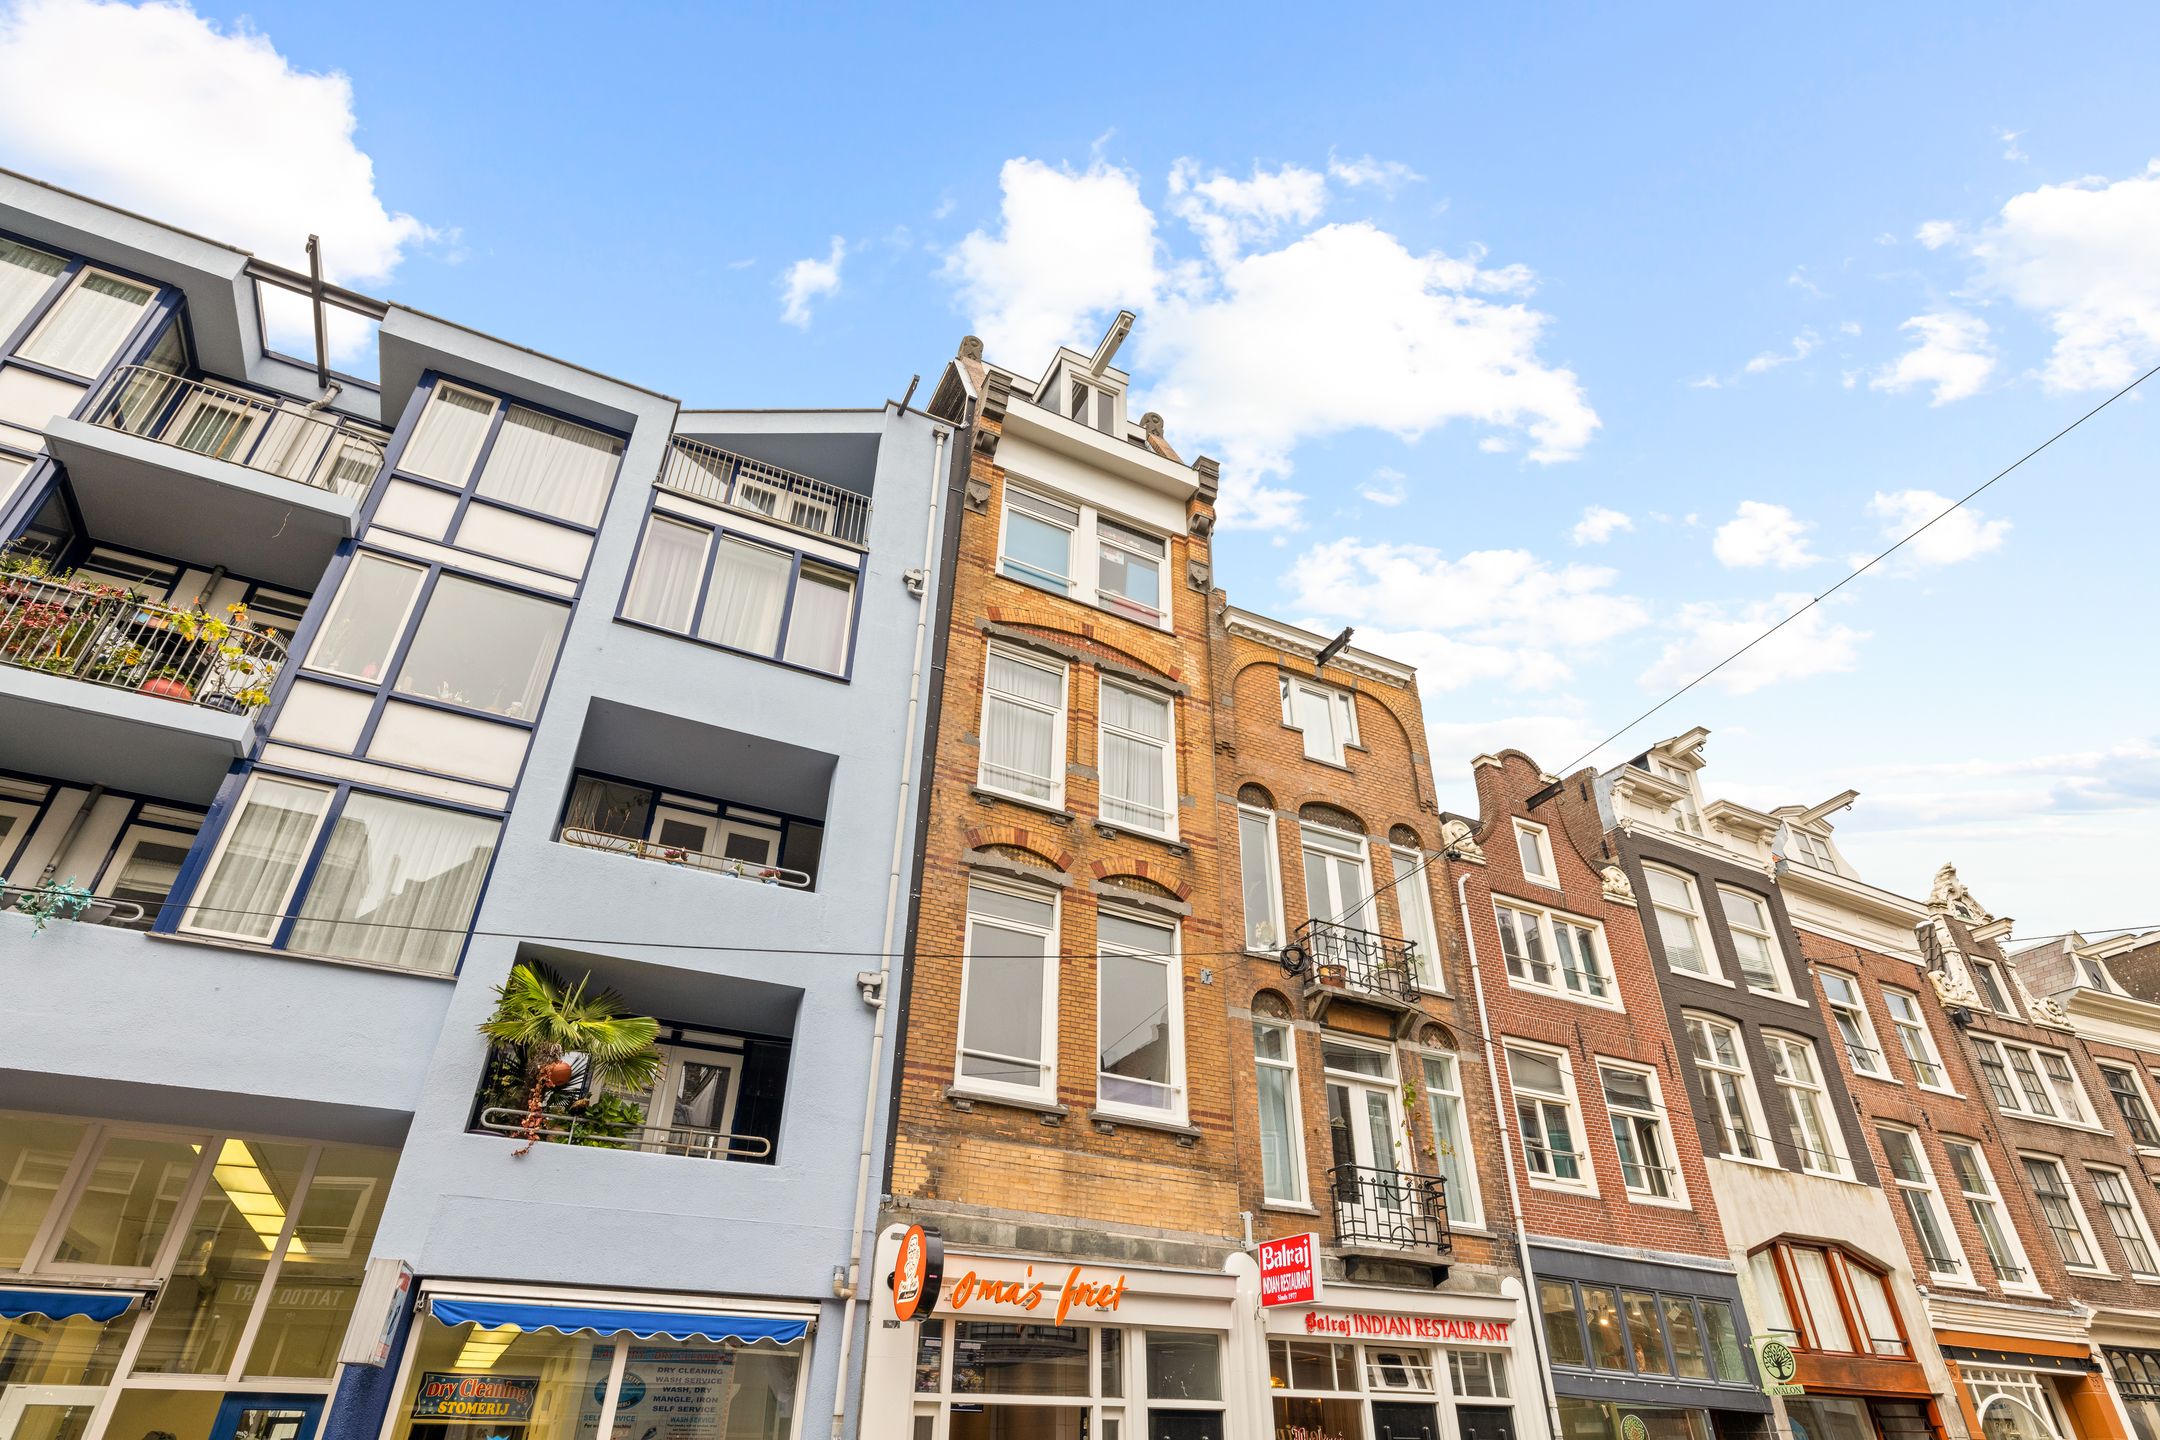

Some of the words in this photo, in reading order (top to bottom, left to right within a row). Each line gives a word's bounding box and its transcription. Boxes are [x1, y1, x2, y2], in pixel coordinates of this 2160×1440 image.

[1262, 1238, 1309, 1270] Balraj
[1262, 1275, 1281, 1294] INDIAN
[1280, 1270, 1311, 1292] RESTAURANT
[951, 1264, 1044, 1310] Oma's
[1055, 1266, 1128, 1327] friet
[1305, 1311, 1350, 1336] Balraj
[1354, 1314, 1412, 1335] INDIAN
[1416, 1319, 1509, 1341] RESTAURANT
[678, 1367, 723, 1375] CLEANING
[426, 1382, 459, 1400] Dry
[459, 1379, 529, 1402] Cleaning
[663, 1386, 691, 1394] WASH,
[684, 1377, 723, 1385] SERVICE
[1772, 1386, 1802, 1395] AVALON
[437, 1401, 510, 1416] STOMERIJ
